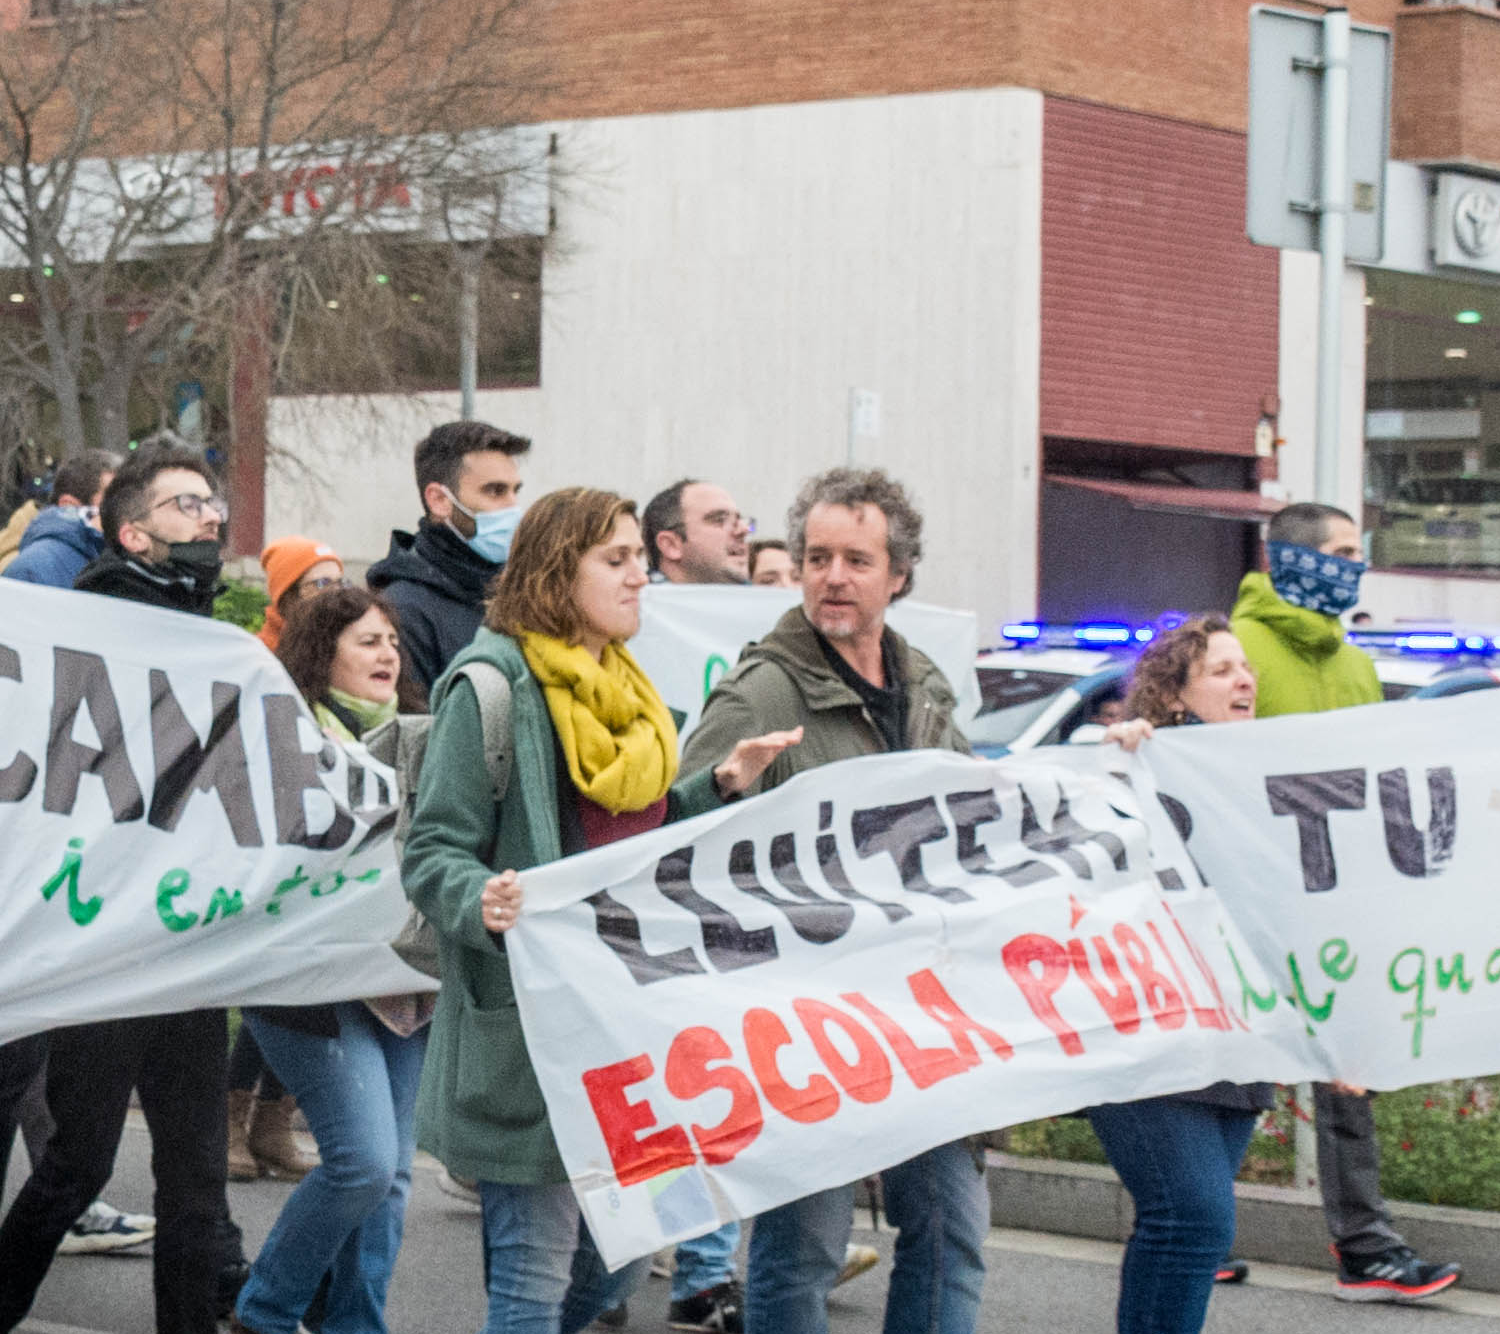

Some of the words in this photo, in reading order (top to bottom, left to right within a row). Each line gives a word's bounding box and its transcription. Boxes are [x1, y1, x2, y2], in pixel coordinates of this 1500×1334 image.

[204, 164, 410, 218] TYOTA
[40, 836, 104, 927] i
[1264, 766, 1457, 893] TU
[582, 968, 1015, 1188] ESCOLA
[1000, 894, 1250, 1058] PÚBLI
